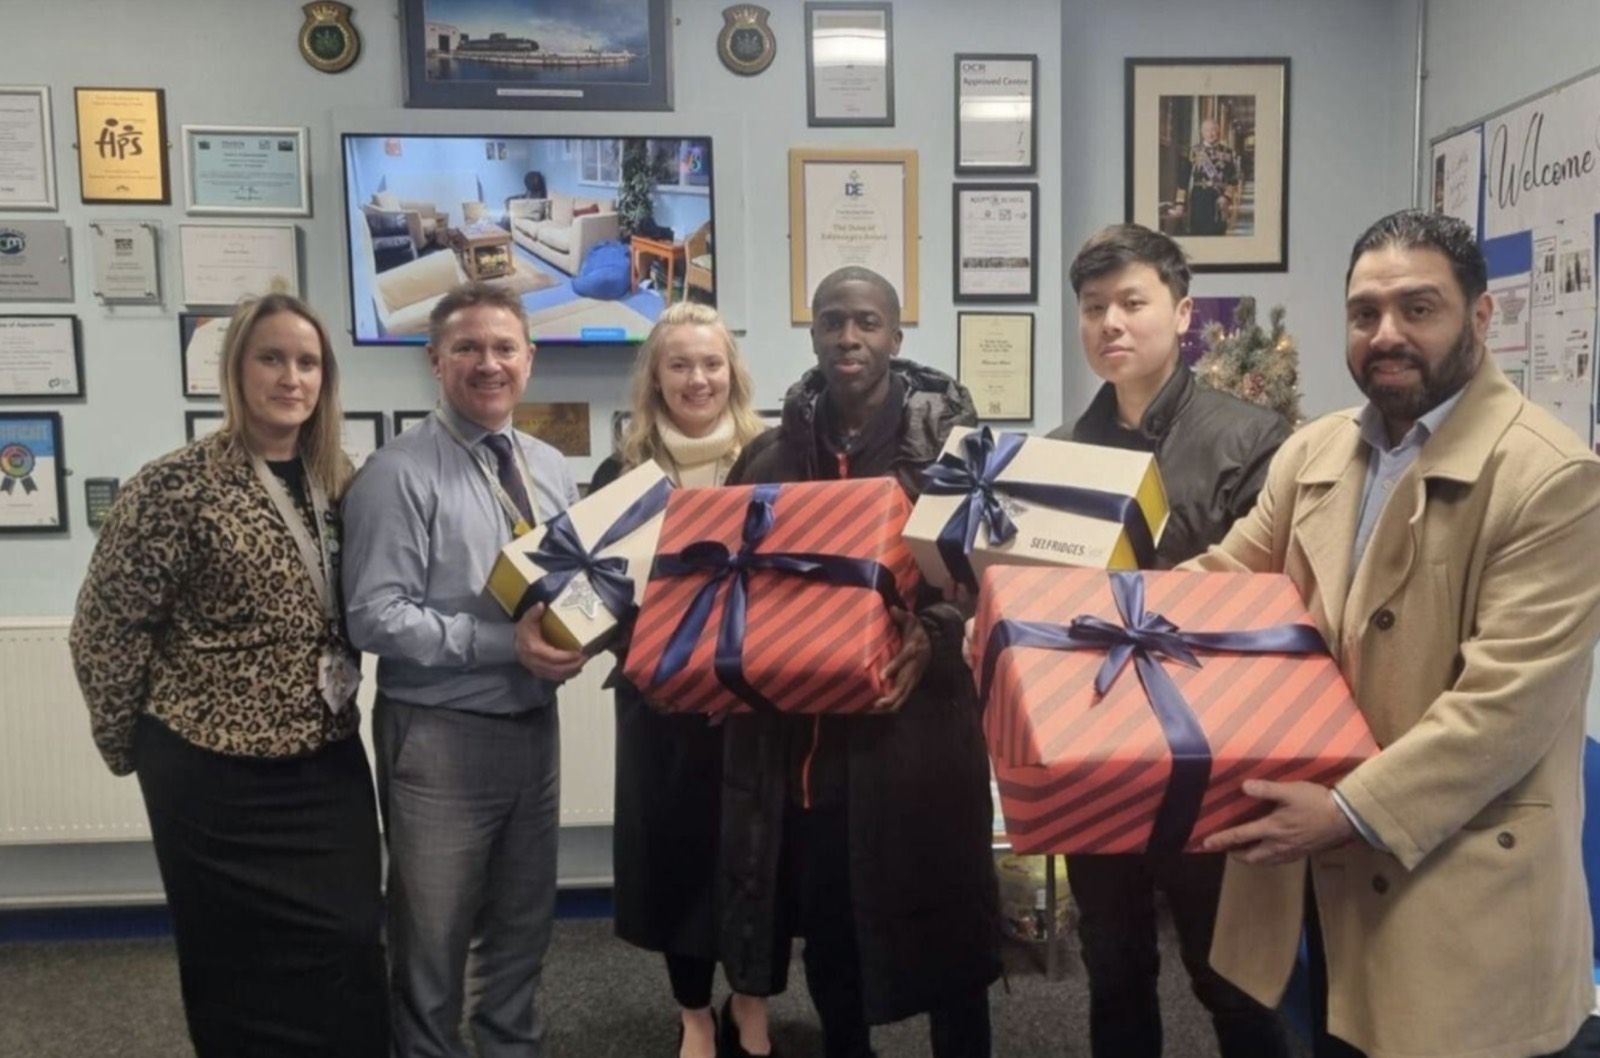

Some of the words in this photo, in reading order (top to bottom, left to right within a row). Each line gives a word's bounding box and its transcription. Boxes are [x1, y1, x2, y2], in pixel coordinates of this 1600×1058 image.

[963, 77, 1001, 86] Approved
[1003, 77, 1028, 86] Centre
[1488, 112, 1596, 209] Welcome
[1030, 536, 1086, 557] SELFRIDGES
